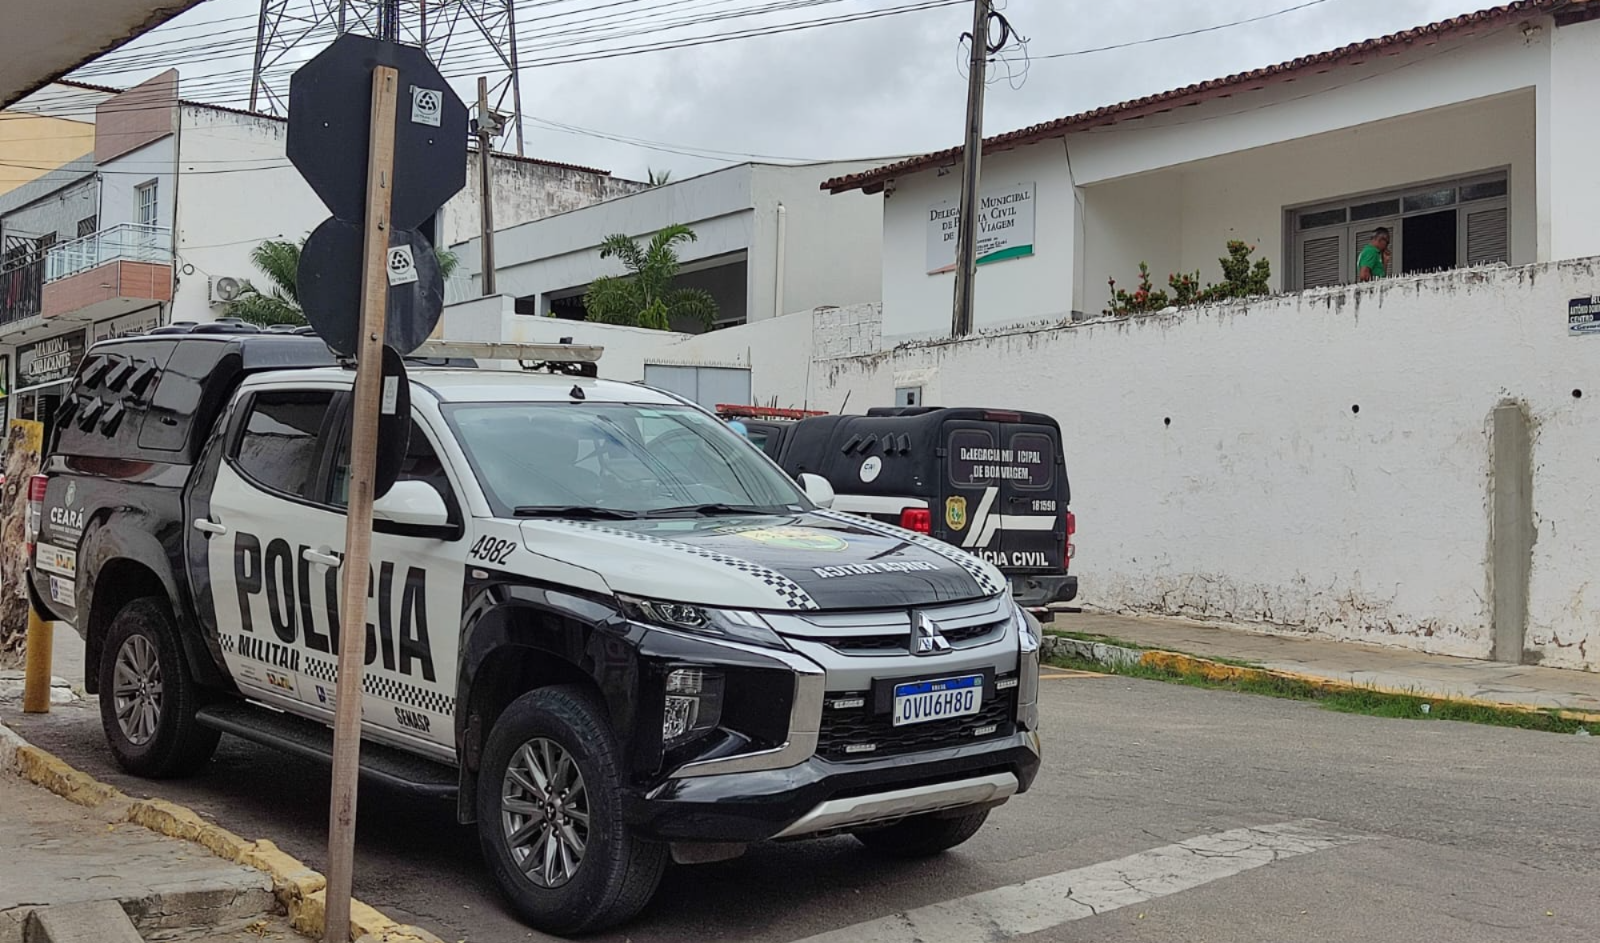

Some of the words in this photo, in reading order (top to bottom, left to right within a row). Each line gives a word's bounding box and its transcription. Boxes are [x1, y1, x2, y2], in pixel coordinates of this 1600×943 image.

[930, 207, 961, 221] DELEGA
[981, 191, 1030, 210] MUNICIPAL
[991, 207, 1017, 220] CIVIL
[980, 219, 1015, 233] VIAGEM
[974, 465, 984, 478] DE
[985, 465, 1000, 478] BOA
[1000, 466, 1029, 479] VIAGEM
[50, 507, 85, 529] CEARÁ
[470, 534, 517, 566] 4982
[1012, 551, 1049, 566] CIVIL
[238, 634, 300, 672] MILITAR
[903, 689, 974, 720] OVU6H80
[394, 706, 431, 733] SENASP
